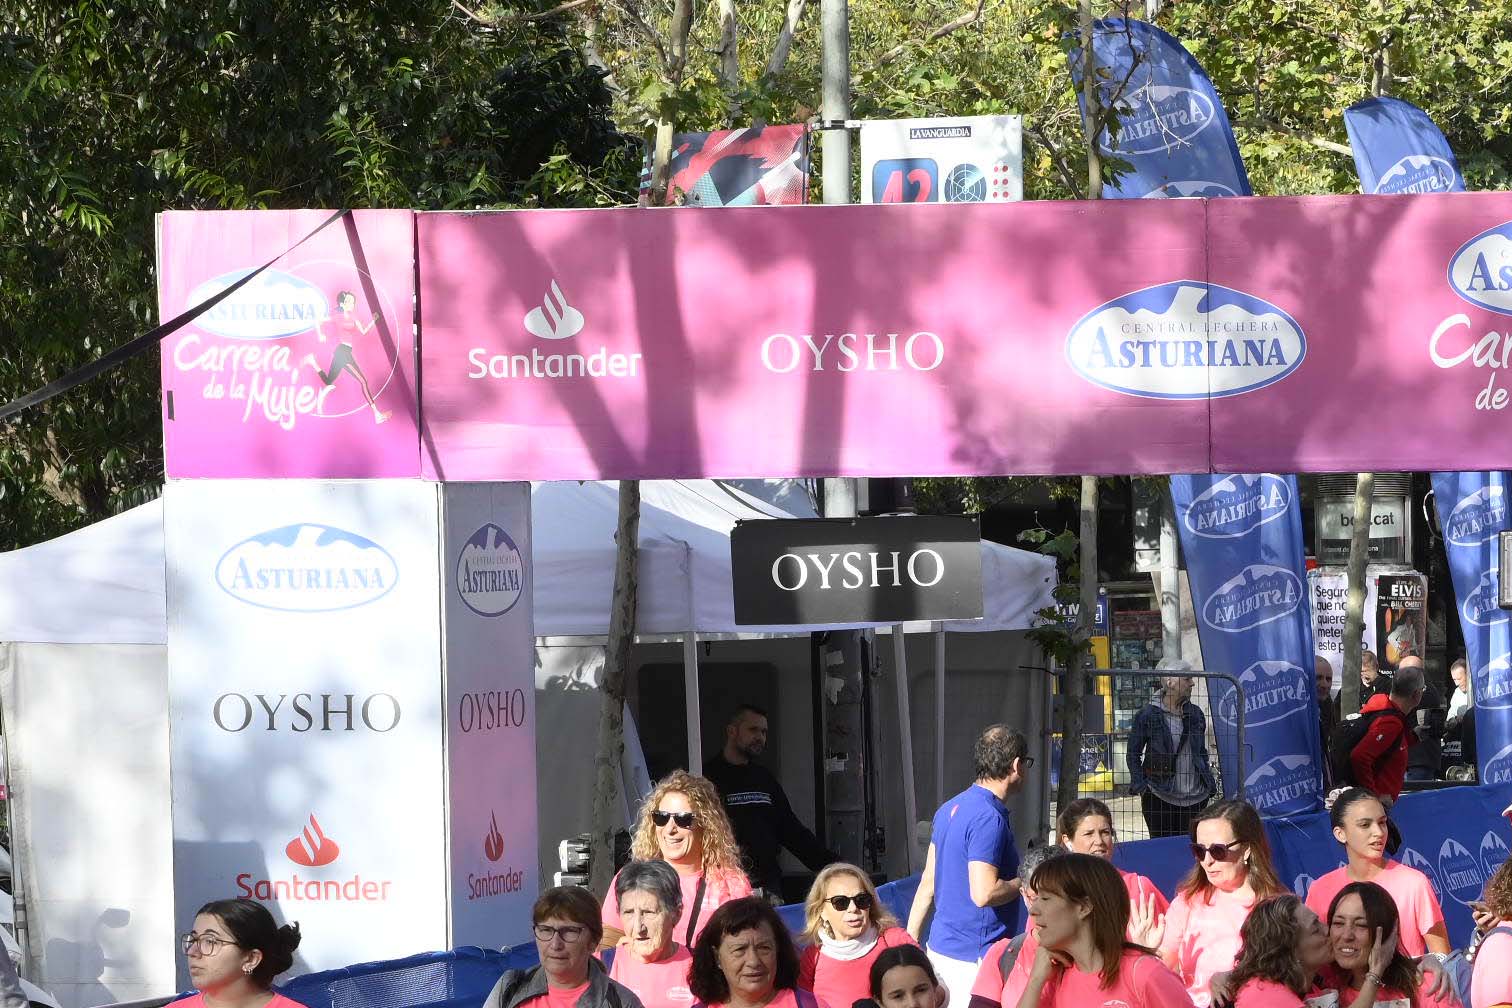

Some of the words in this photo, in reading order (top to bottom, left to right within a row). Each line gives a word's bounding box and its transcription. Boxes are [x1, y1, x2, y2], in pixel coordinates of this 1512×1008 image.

[1203, 320, 1280, 332] LECHERA
[173, 334, 292, 371] Carrera
[468, 346, 642, 379] Santander
[761, 332, 945, 373] OYSHO
[1086, 332, 1288, 370] ASTURIANA
[202, 376, 224, 399] de
[229, 371, 244, 399] la
[242, 370, 336, 430] Mujer
[1475, 373, 1509, 410] de
[230, 556, 386, 592] ASTURIANA
[461, 558, 520, 594] ASTURIANA
[771, 549, 945, 591] OYSHO
[1391, 584, 1422, 597] ELVIS
[1318, 641, 1336, 651] este
[213, 692, 401, 733] OYSHO
[459, 688, 525, 733] OYSHO
[235, 873, 392, 901] Santander
[468, 867, 523, 901] Santander
